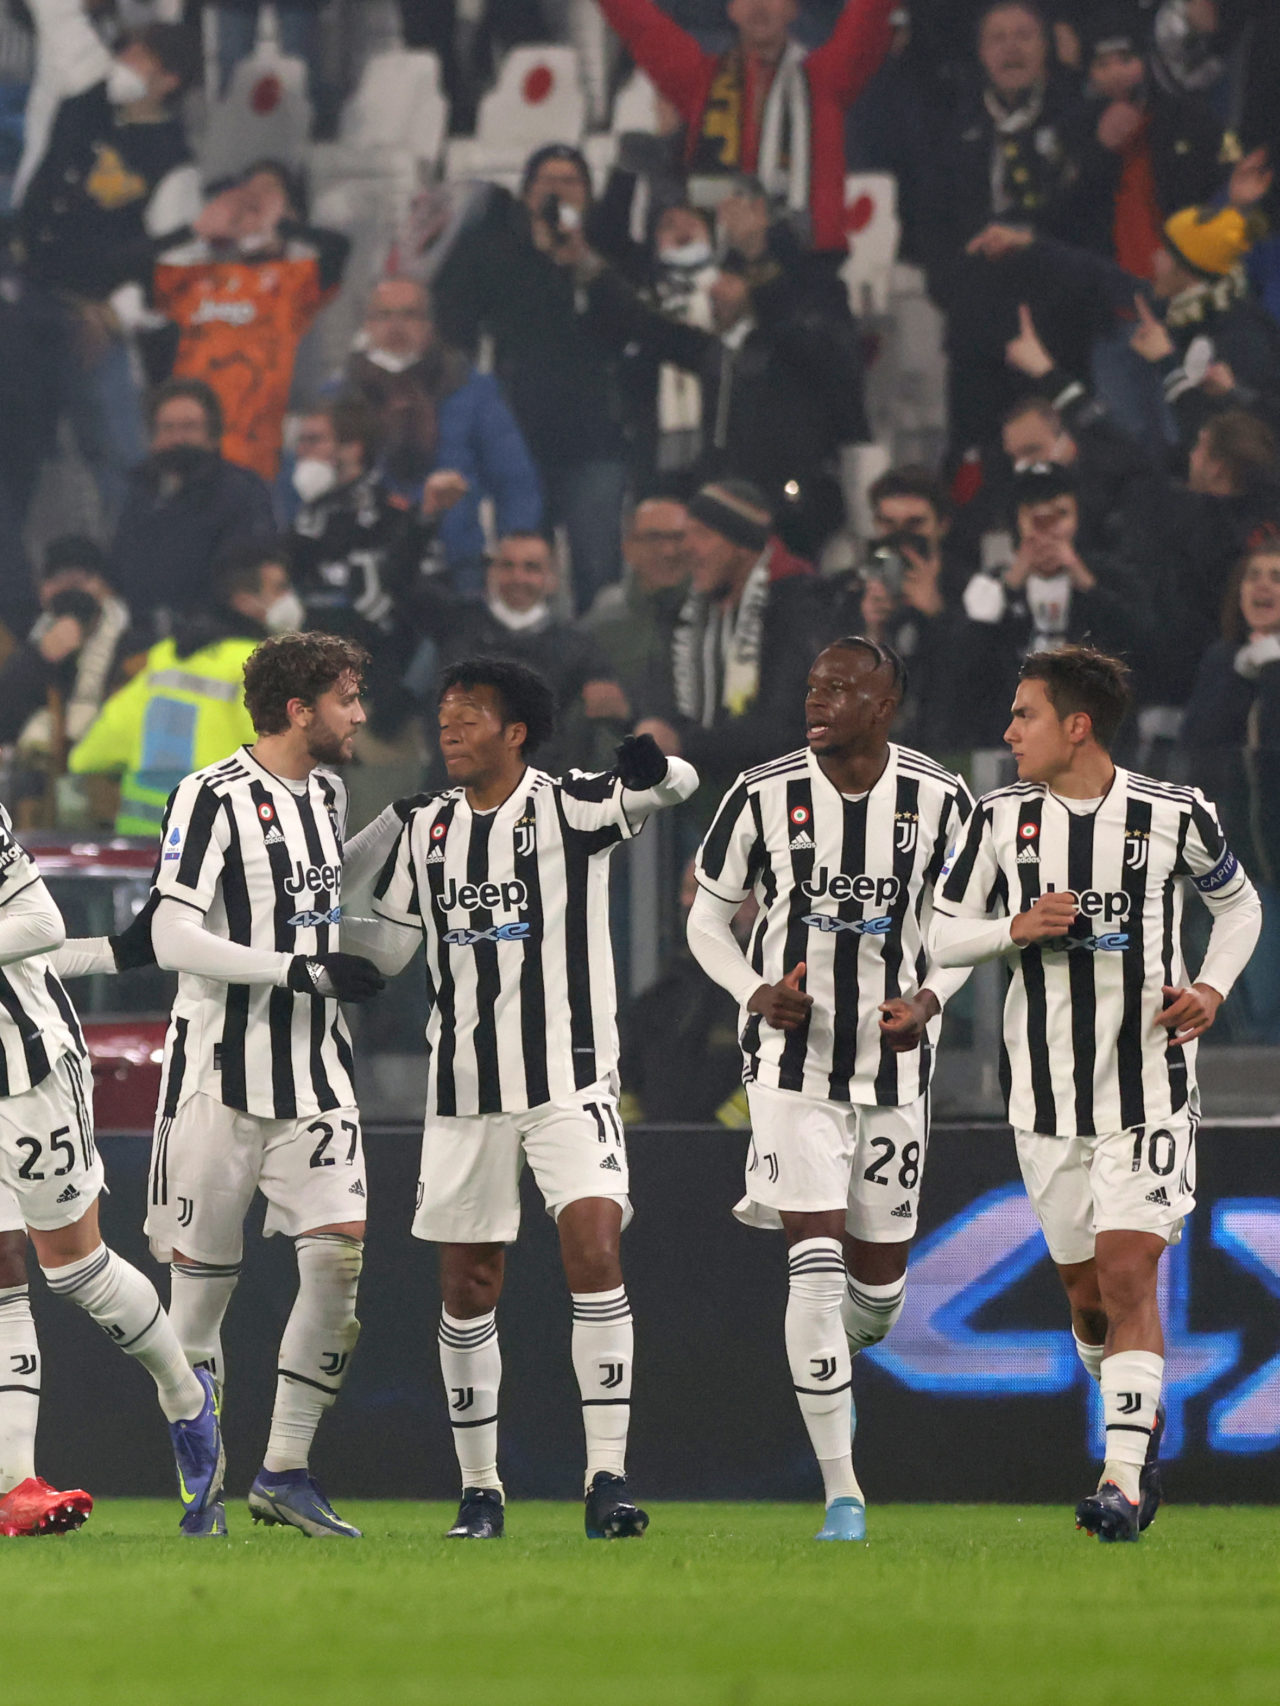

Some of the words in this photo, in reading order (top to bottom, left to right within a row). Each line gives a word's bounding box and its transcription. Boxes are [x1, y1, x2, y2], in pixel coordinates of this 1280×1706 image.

[437, 878, 527, 912] Jeep
[801, 866, 899, 907] Jeep
[1030, 883, 1131, 923] ep
[307, 1119, 358, 1169] 27
[582, 1102, 622, 1148] 11
[15, 1125, 76, 1181] 25
[863, 1136, 920, 1190] 28
[1130, 1126, 1177, 1177] 10
